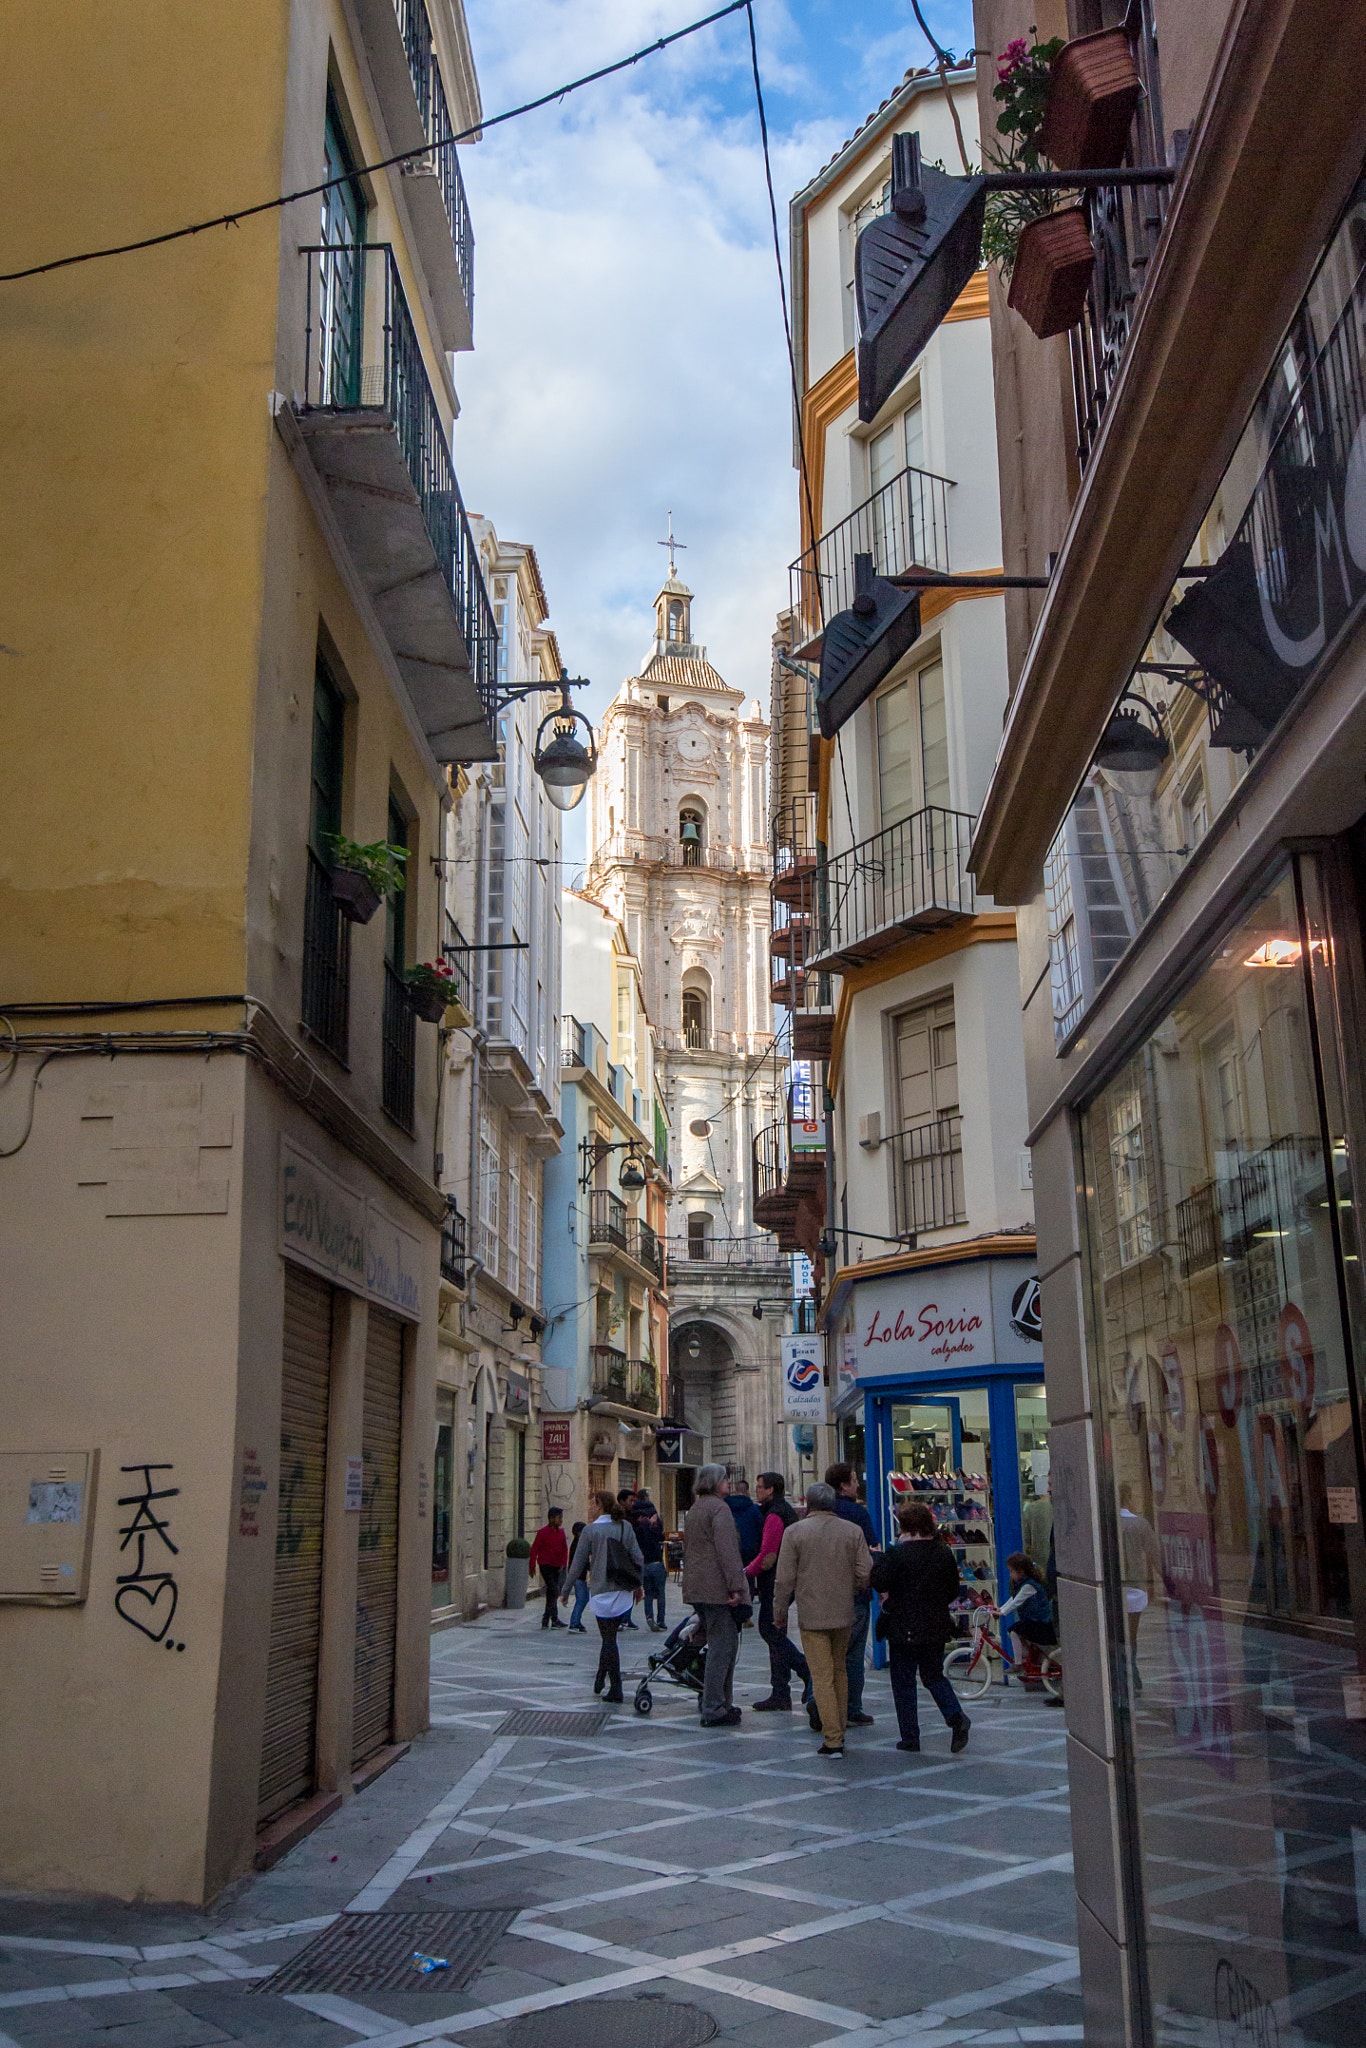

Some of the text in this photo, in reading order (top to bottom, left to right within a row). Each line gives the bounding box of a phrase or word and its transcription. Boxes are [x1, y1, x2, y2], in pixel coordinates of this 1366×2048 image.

[863, 1303, 983, 1347] Lola Soria
[1008, 1320, 1031, 1344] GRUPO
[931, 1338, 974, 1362] calzados
[788, 1395, 821, 1404] Calzados
[791, 1409, 801, 1417] Tu
[810, 1409, 820, 1417] Yo
[549, 1433, 566, 1444] ZALI
